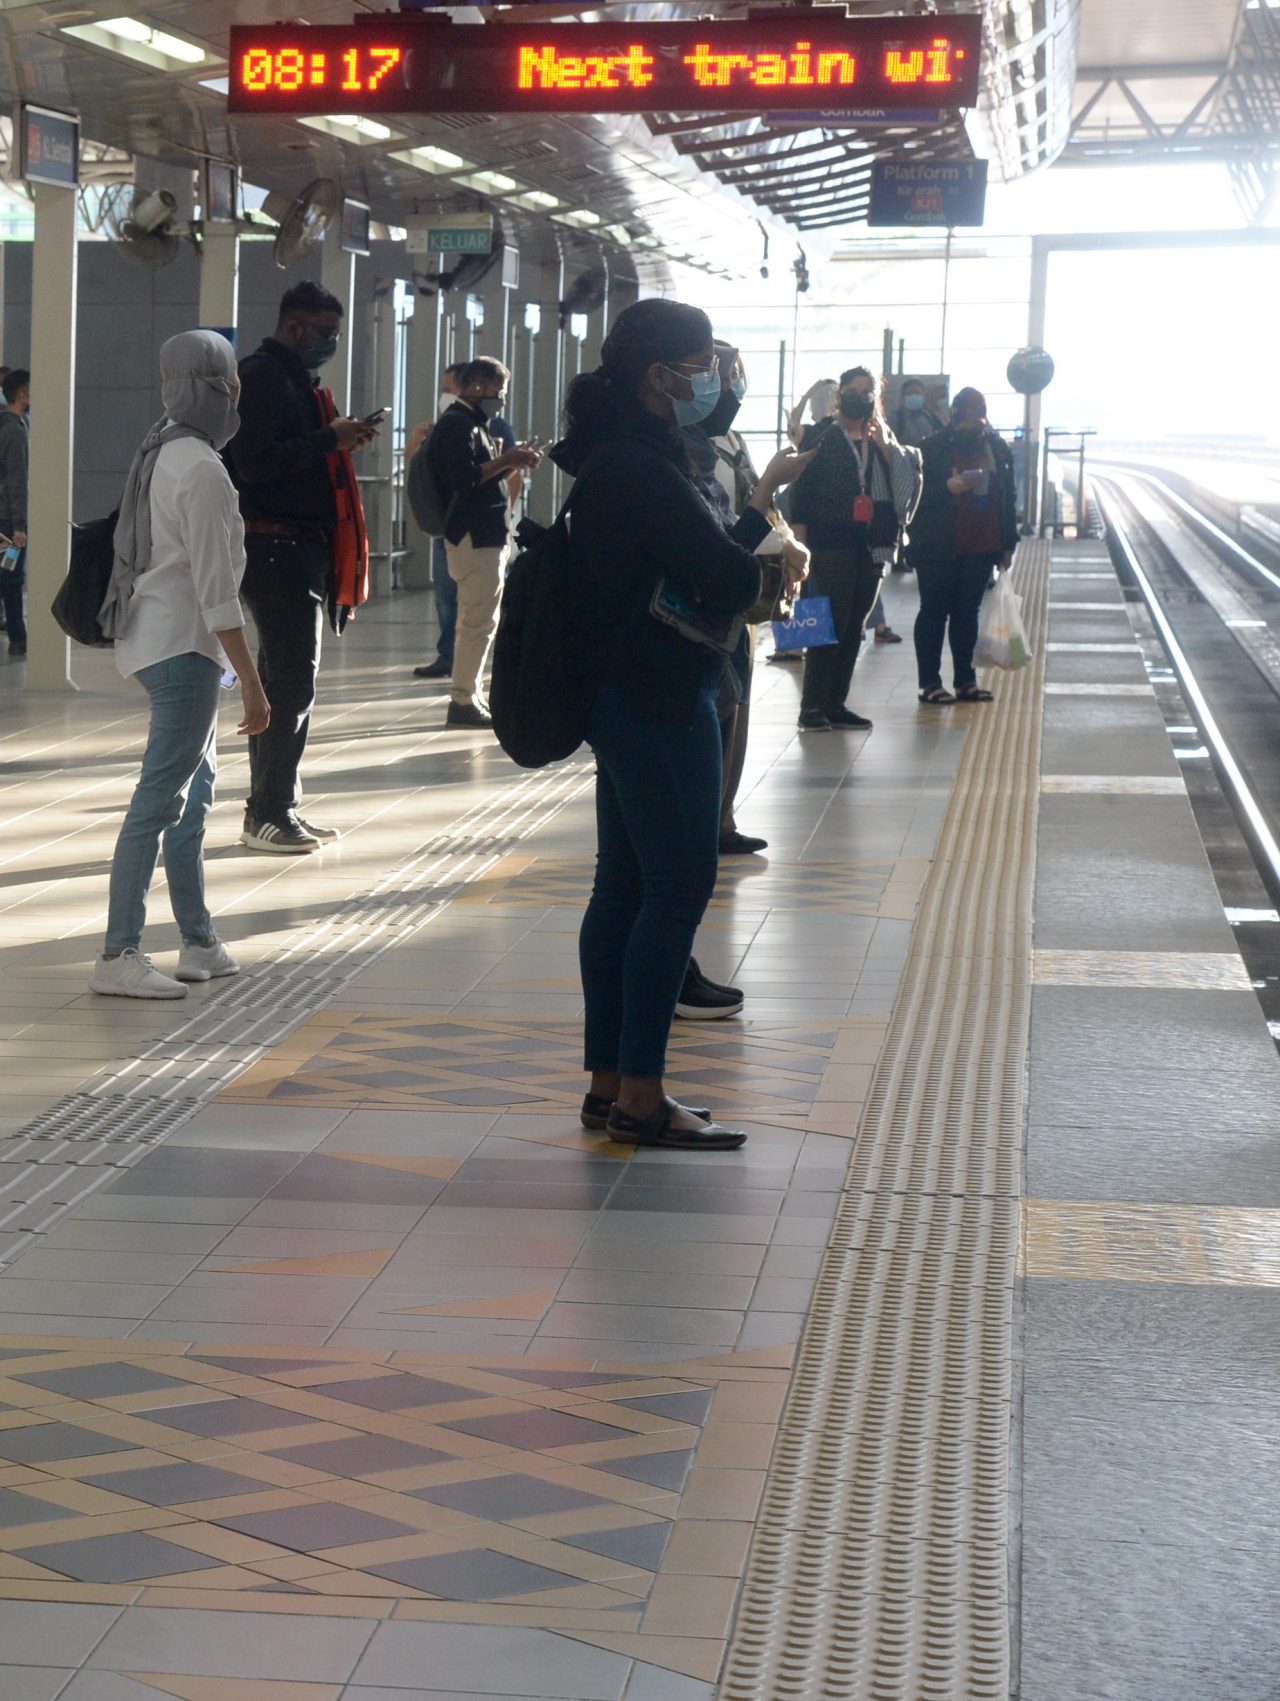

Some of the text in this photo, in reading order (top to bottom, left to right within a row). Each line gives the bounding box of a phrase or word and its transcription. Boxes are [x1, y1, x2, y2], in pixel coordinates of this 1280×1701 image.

[243, 48, 400, 90] 08:17
[518, 38, 964, 89] Next train wi
[883, 164, 974, 181] Platform 1
[903, 210, 947, 222] Gombak
[430, 231, 487, 250] KELUAR
